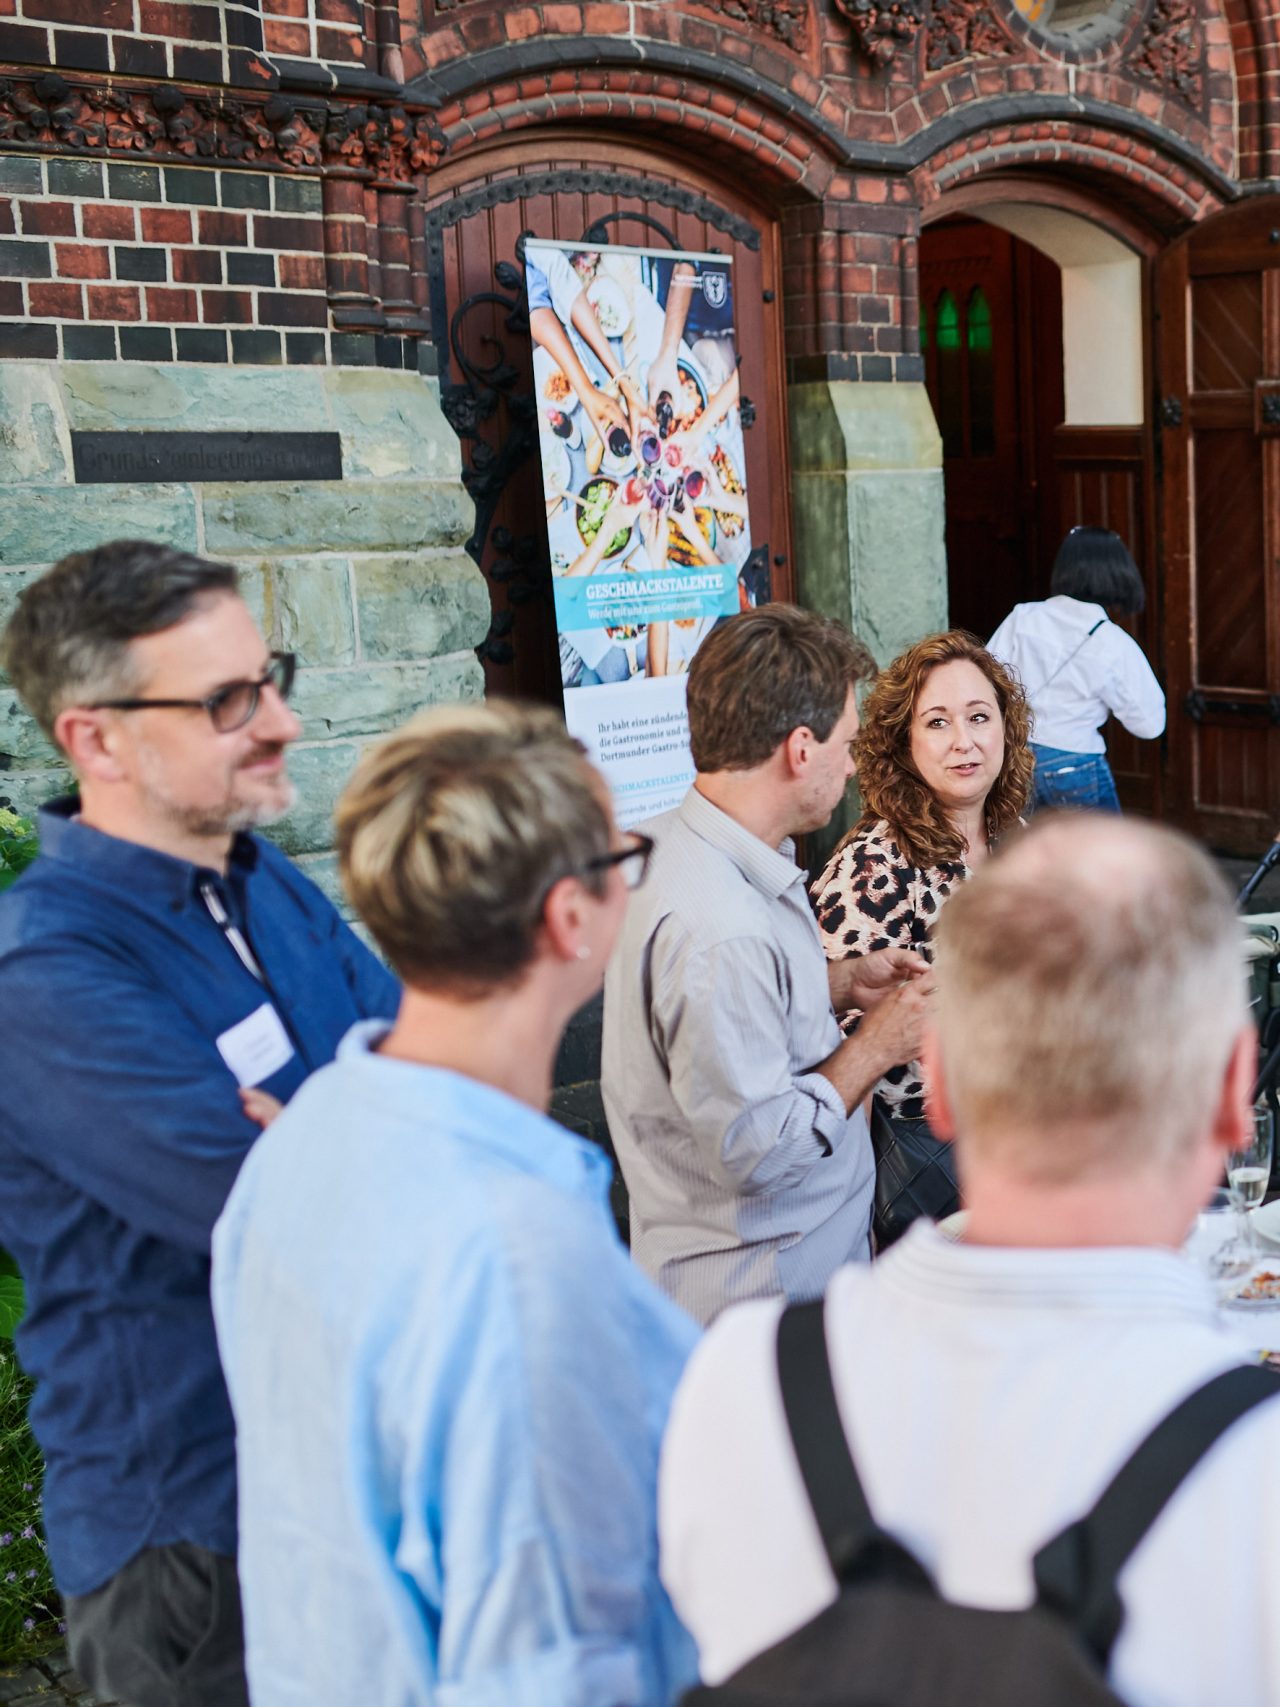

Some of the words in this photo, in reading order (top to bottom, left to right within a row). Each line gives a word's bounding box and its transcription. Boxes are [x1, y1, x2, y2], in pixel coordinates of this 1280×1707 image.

[586, 574, 724, 600] GESCHMACKSTALENTE
[598, 723, 610, 733] Ihr
[612, 719, 630, 730] habt
[631, 717, 649, 727] eine
[600, 737, 611, 748] die
[613, 729, 664, 745] Gastronomie
[666, 726, 681, 737] und
[601, 746, 650, 762] Dortmunder
